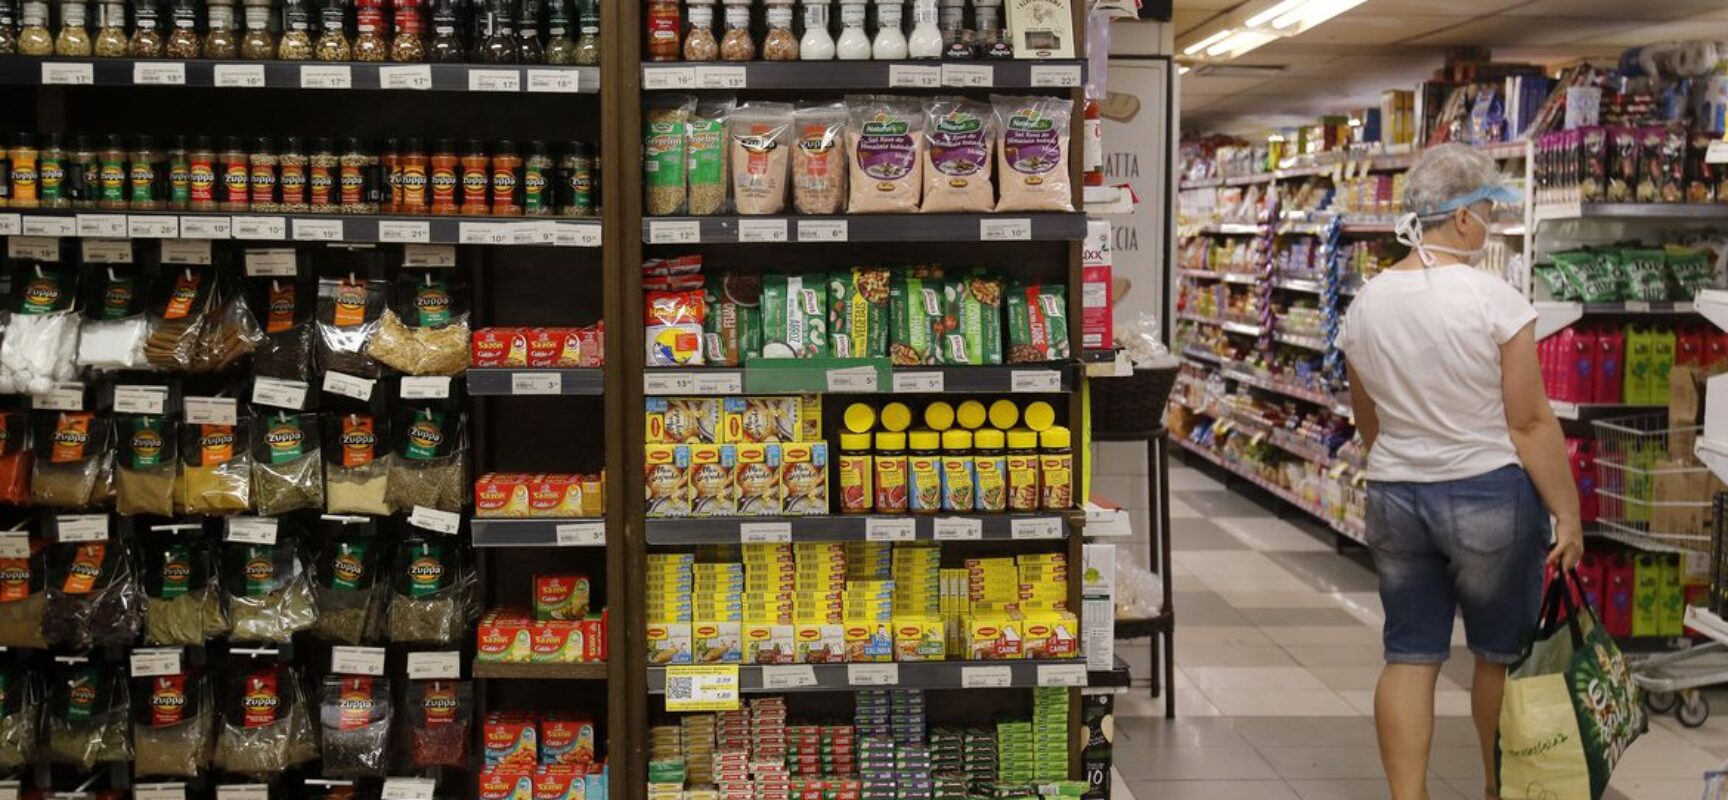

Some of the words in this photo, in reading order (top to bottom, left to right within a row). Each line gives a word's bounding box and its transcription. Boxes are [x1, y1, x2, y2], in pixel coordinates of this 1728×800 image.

[1102, 153, 1139, 177] ATTA
[417, 297, 449, 306] Zuppa
[853, 301, 867, 339] VEGETAIS
[55, 433, 87, 443] Zuppa
[269, 431, 301, 442] Zuppa
[411, 426, 440, 442] Zuppa
[343, 435, 375, 444] Zuppa
[411, 565, 441, 574] Zuppa
[153, 697, 184, 707] Zuppa
[245, 697, 276, 707] Zuppa
[340, 699, 372, 709] Zuppa
[425, 698, 457, 708] Zuppa
